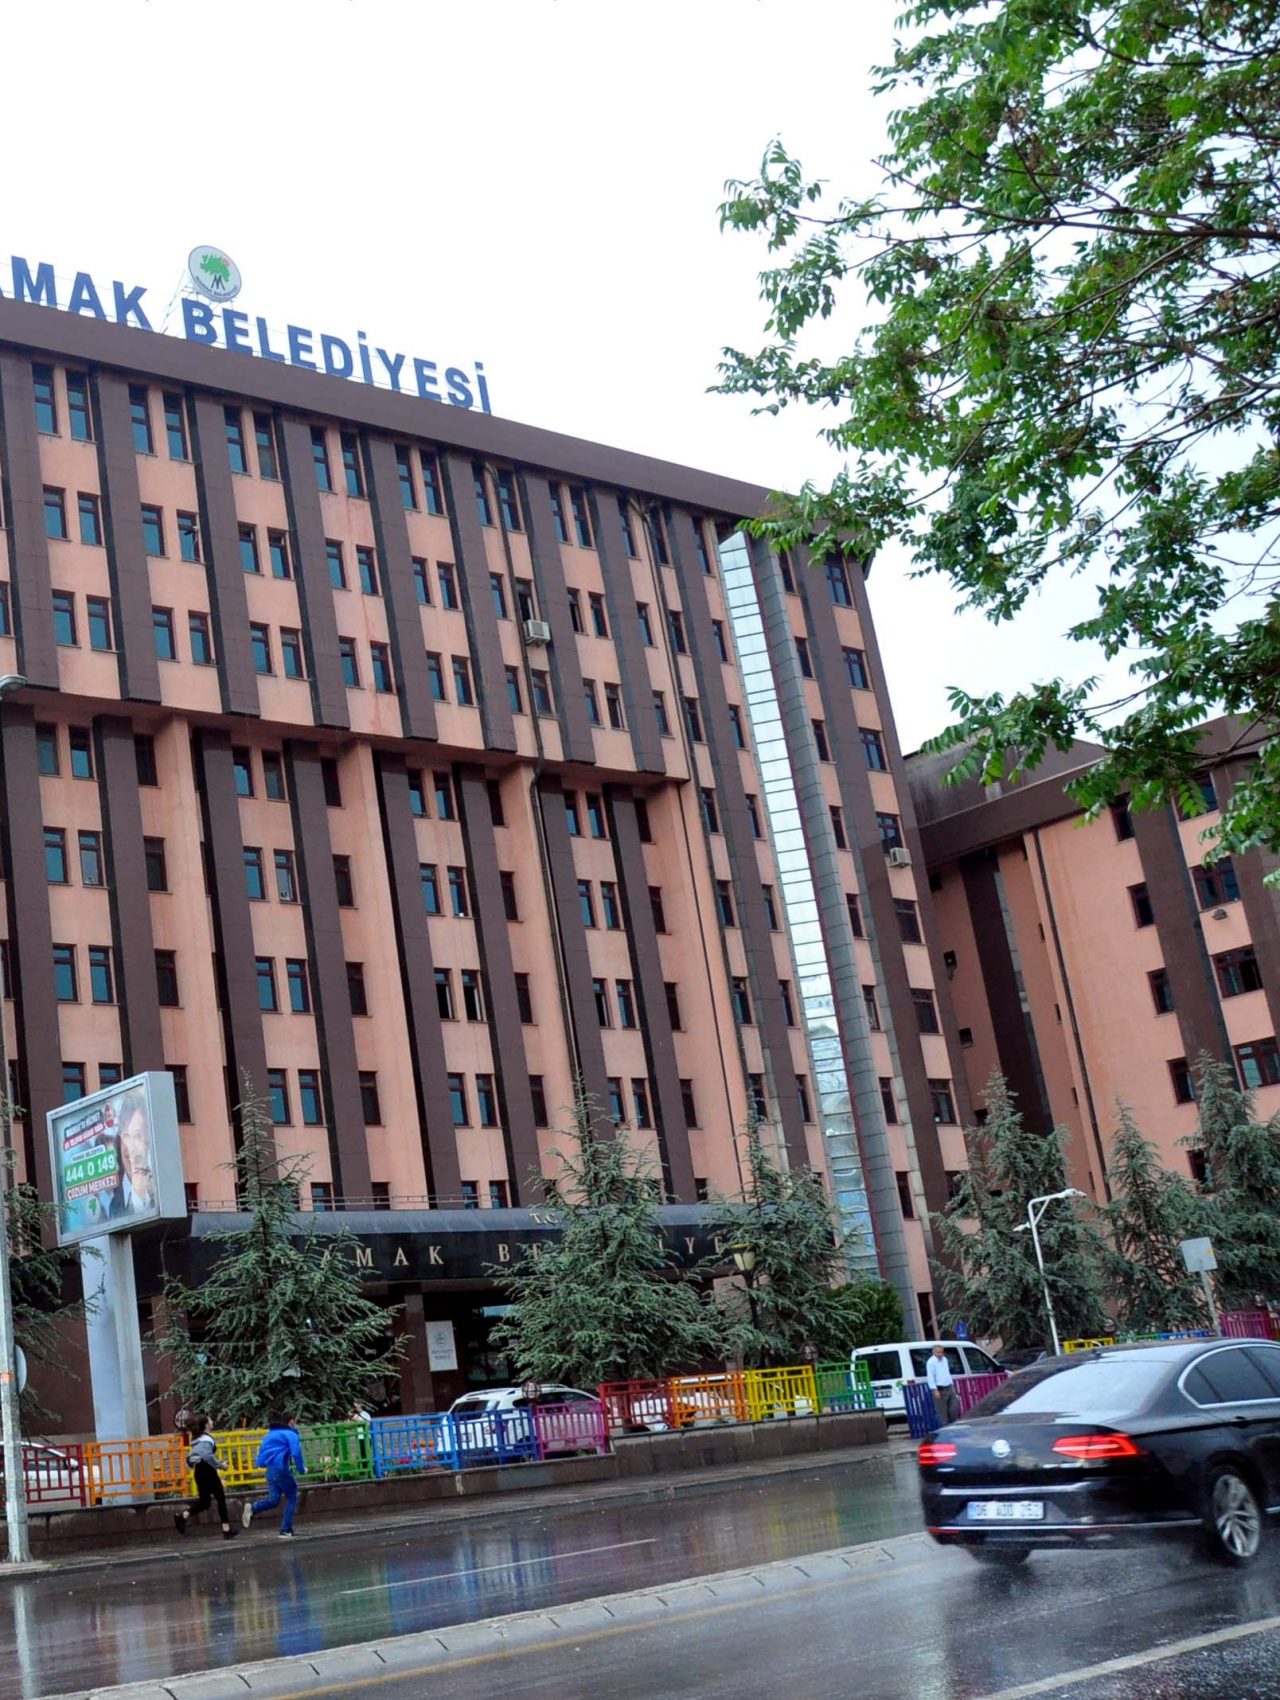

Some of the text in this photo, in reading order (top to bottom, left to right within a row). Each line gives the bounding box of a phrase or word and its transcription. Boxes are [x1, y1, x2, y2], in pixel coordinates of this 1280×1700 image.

[181, 298, 492, 416] BELEDİYESİ
[65, 1154, 116, 1183] 444 0 149
[277, 1245, 444, 1269] AMAK
